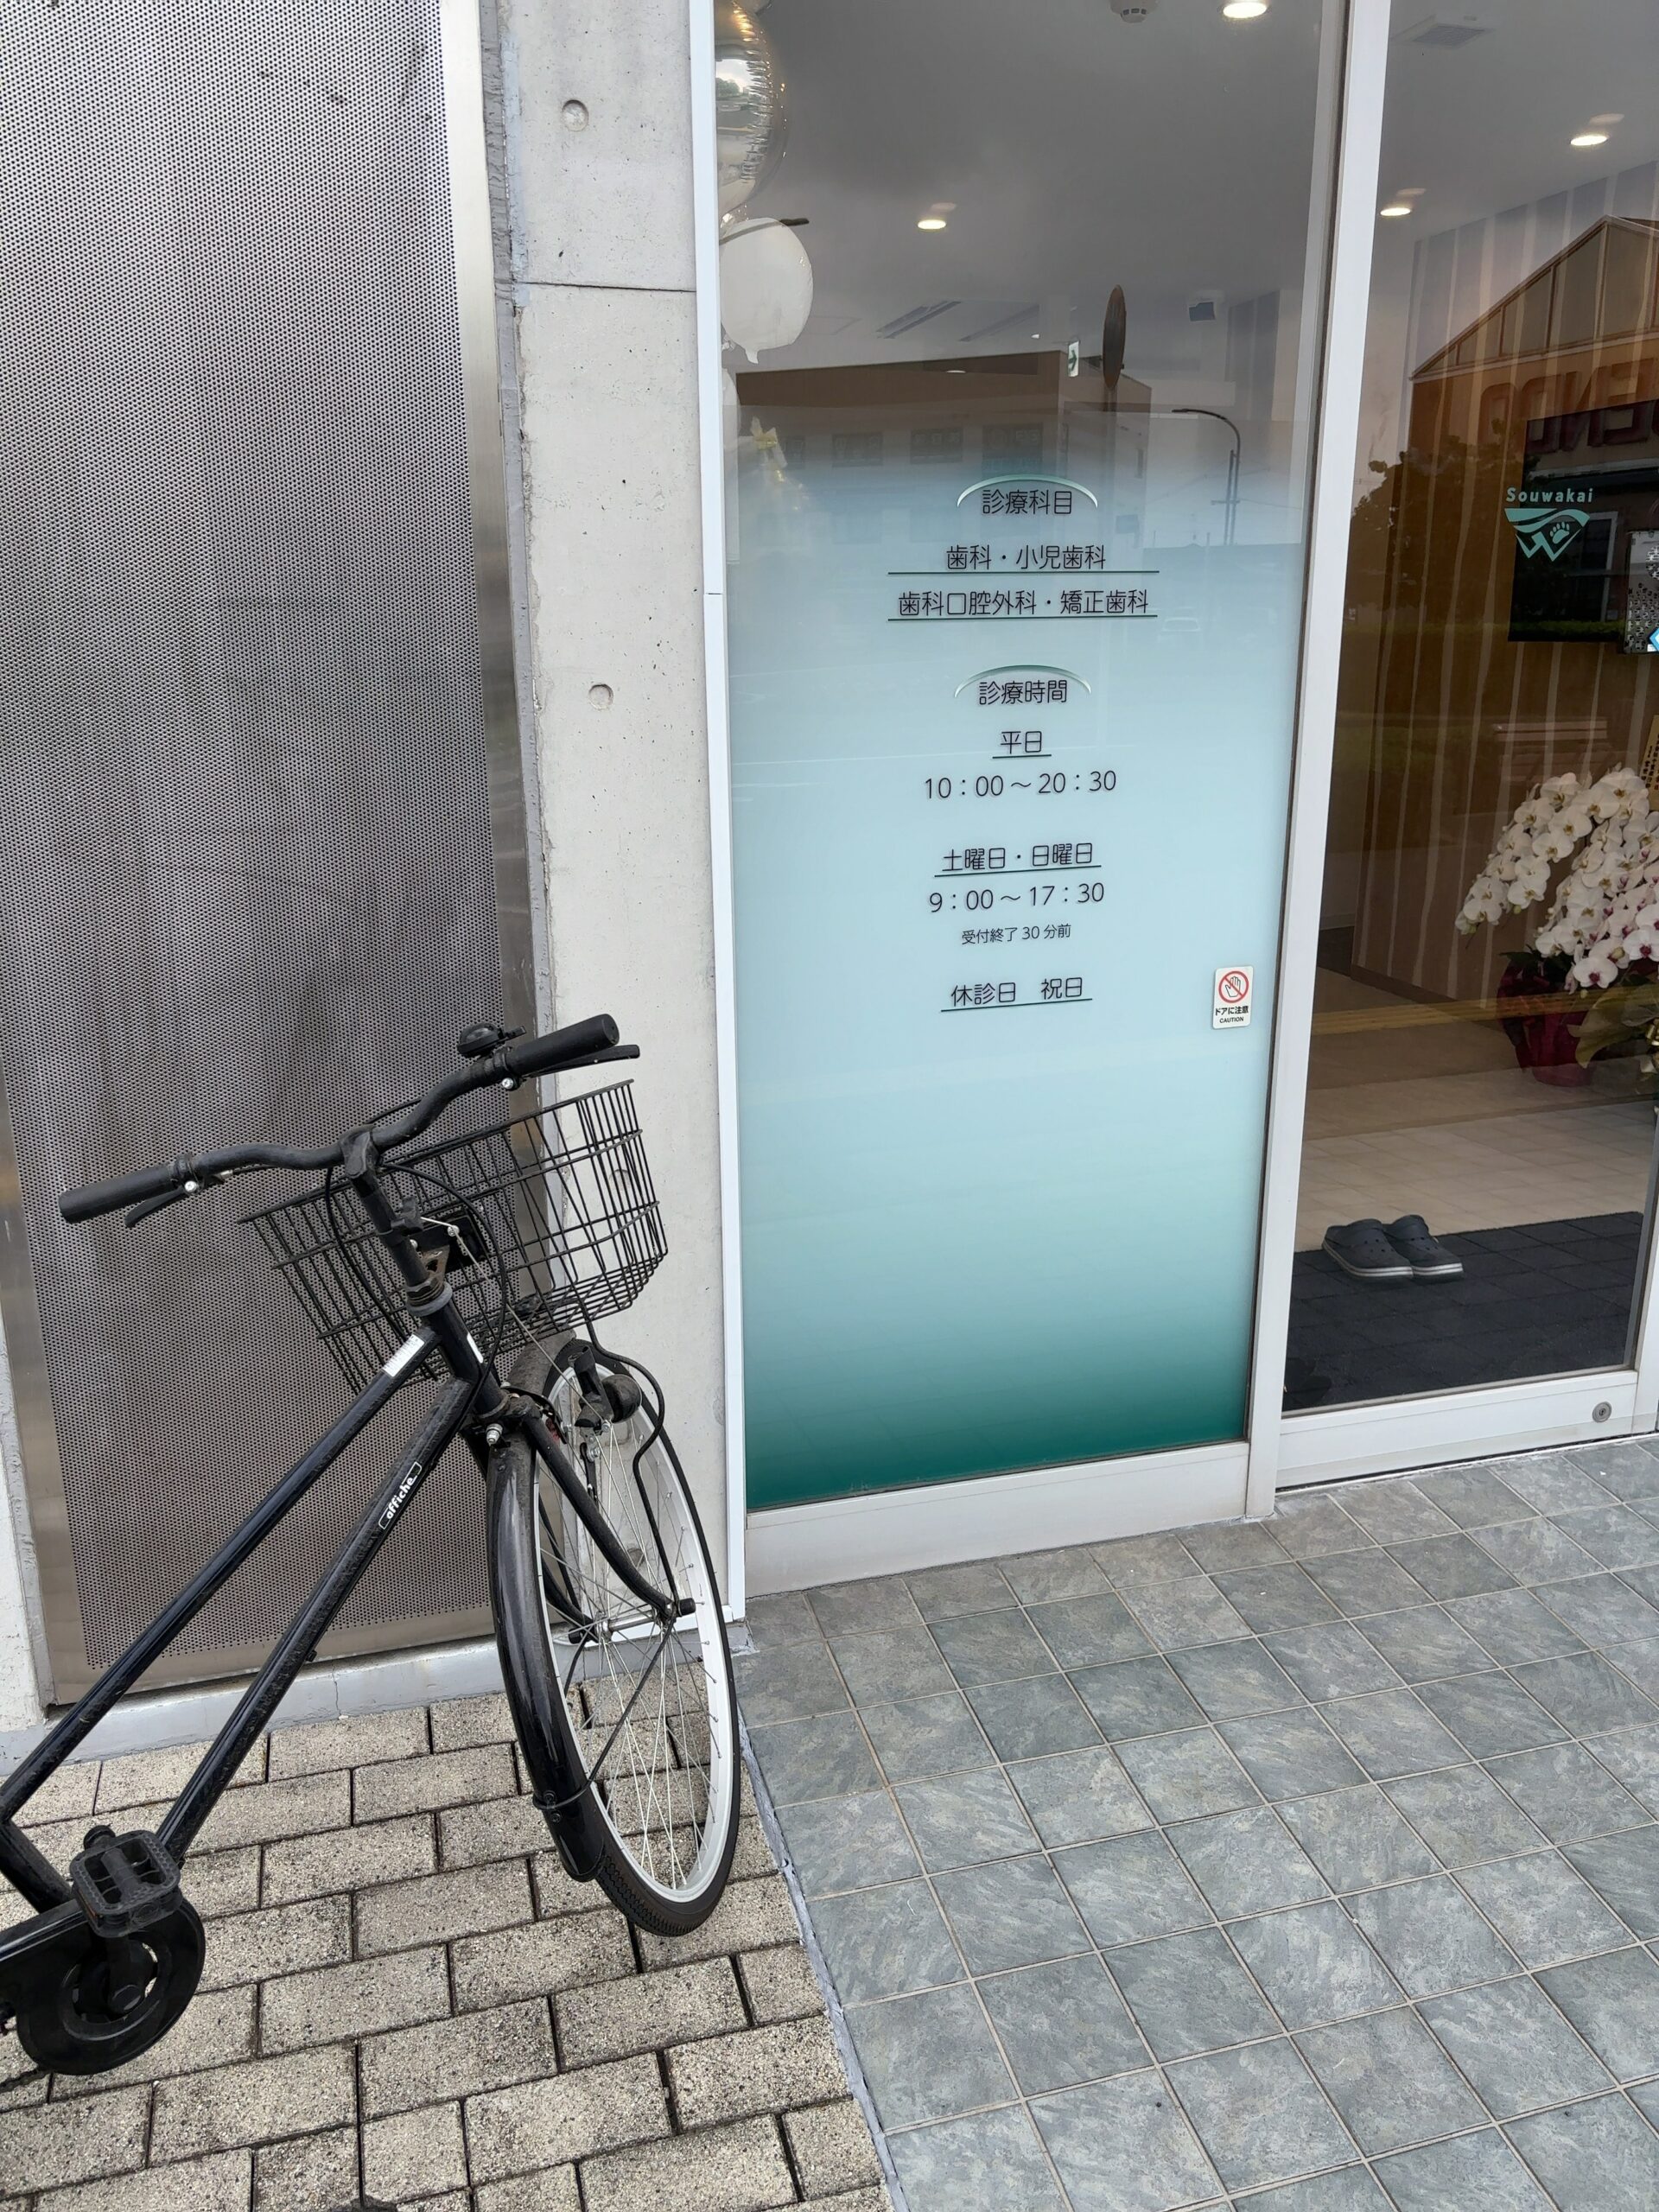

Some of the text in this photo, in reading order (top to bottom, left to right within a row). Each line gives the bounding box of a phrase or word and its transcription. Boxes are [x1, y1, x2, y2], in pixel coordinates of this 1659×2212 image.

[981, 487, 1073, 515] 診療科目
[1506, 486, 1593, 503] Souwakai
[946, 544, 1106, 570] 歯科・小児歯科
[898, 589, 1148, 616] 歯科口腔外科・矯正歯科
[979, 679, 1068, 706] 診療時間
[1000, 730, 1043, 754] 平日
[942, 842, 1093, 873] 土曜日・日曜日
[950, 976, 1084, 1007] 休診日 祝日
[1215, 1005, 1249, 1016] ドアに注意
[386, 1477, 415, 1519] affiche
